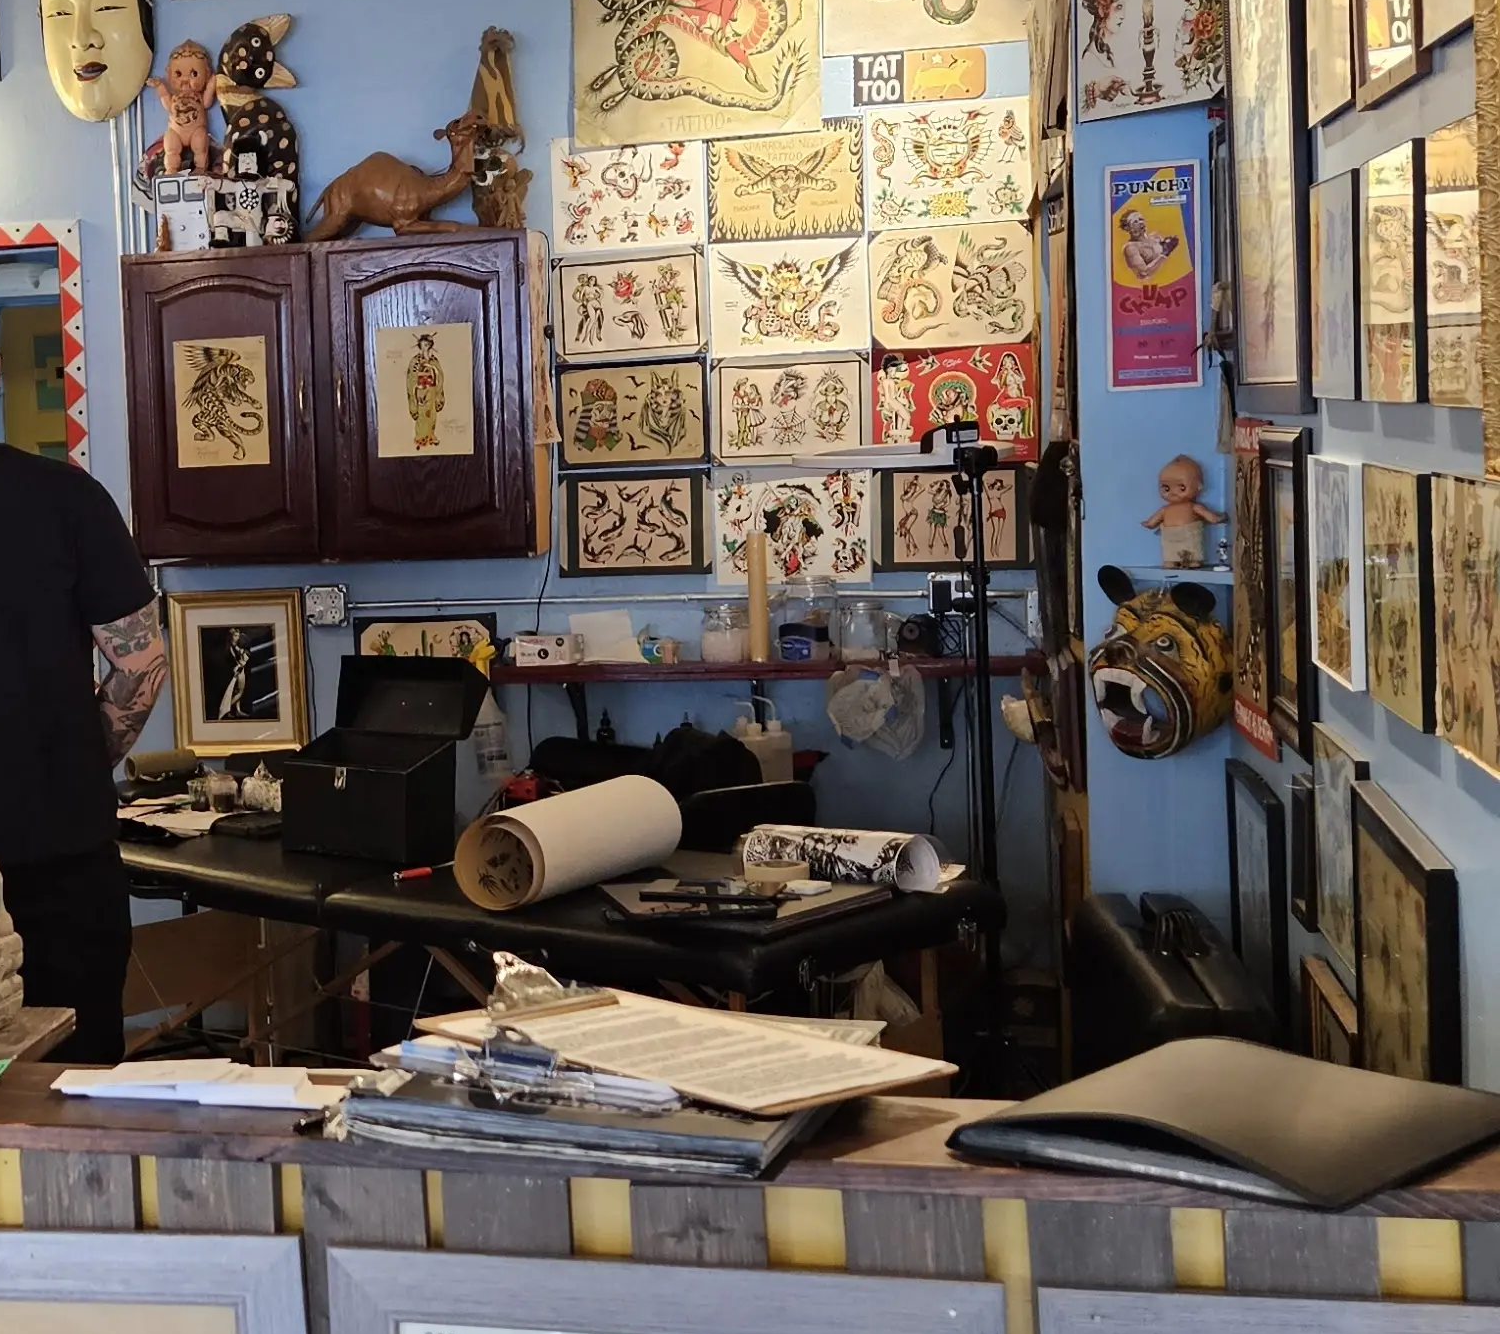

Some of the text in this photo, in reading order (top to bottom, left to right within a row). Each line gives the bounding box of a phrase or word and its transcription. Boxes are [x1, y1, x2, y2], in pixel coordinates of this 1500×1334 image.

[858, 54, 902, 80] TAT
[858, 79, 901, 102] TOO
[666, 112, 725, 133] TATTOO
[767, 151, 803, 162] TATTOO
[1112, 177, 1192, 196] PUNCHY
[1118, 284, 1188, 316] CHUMP
